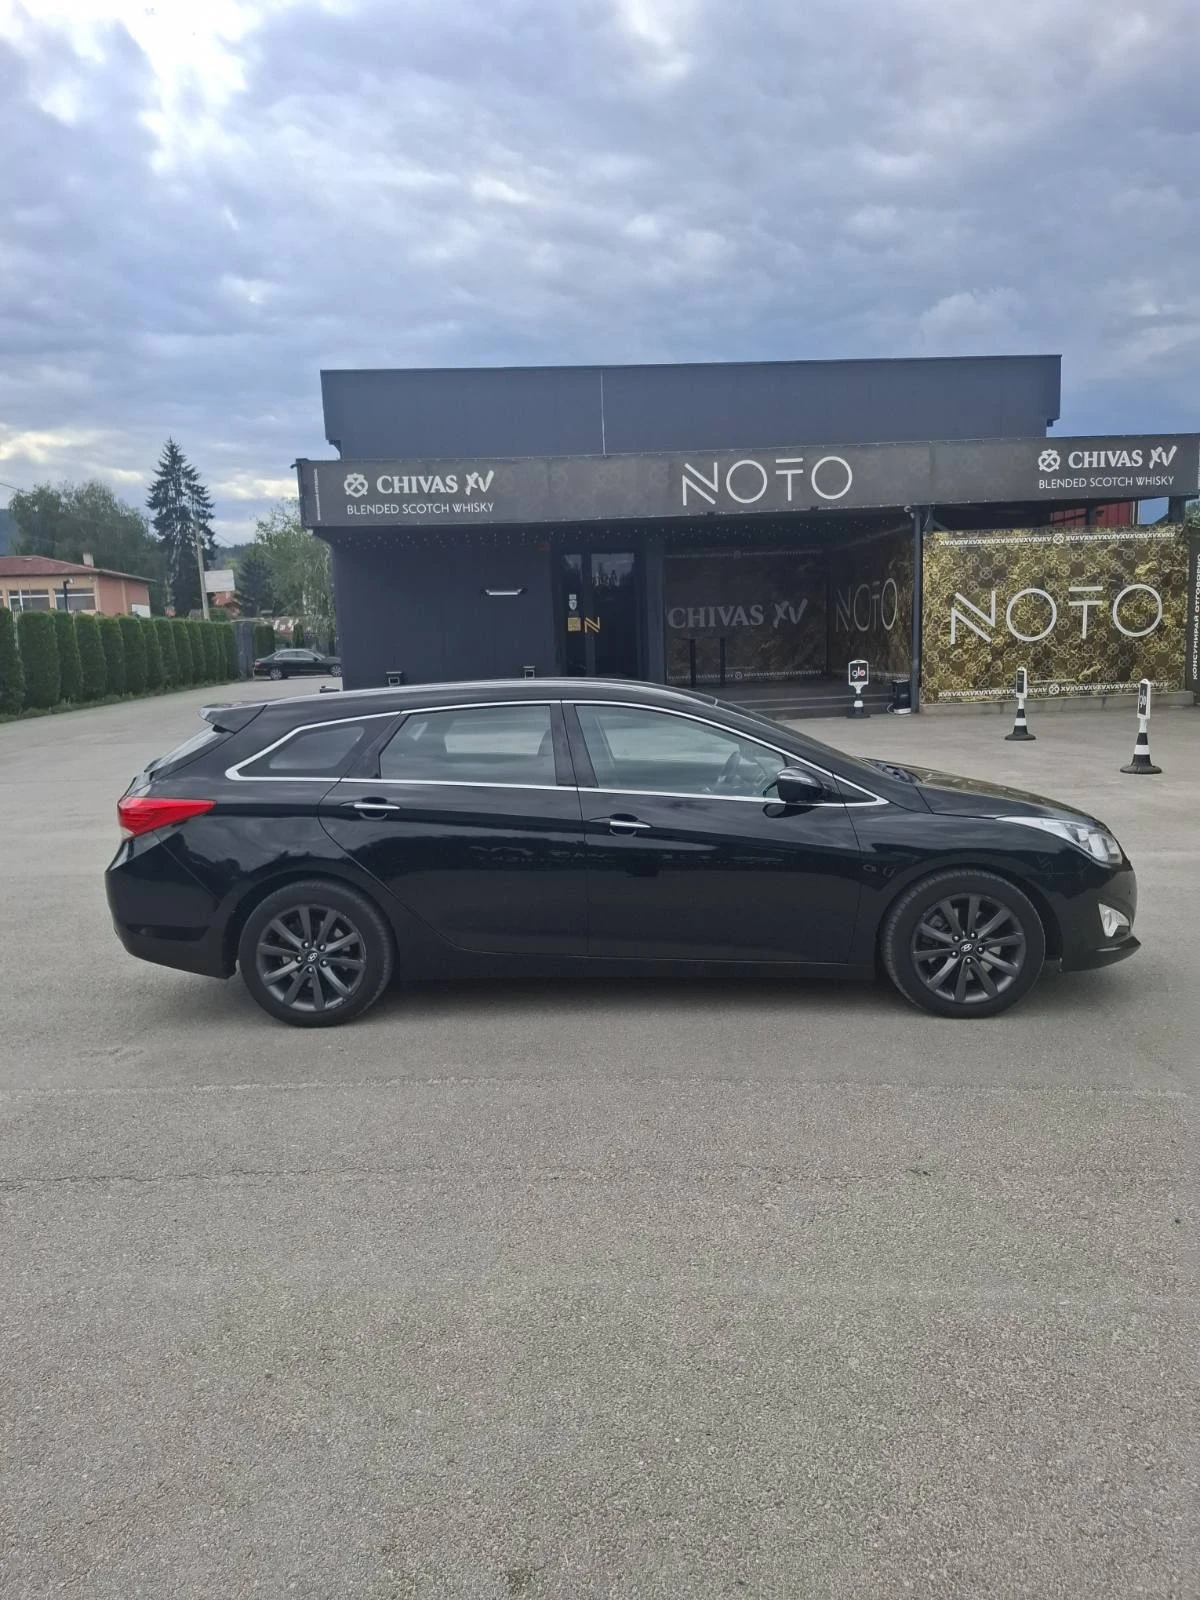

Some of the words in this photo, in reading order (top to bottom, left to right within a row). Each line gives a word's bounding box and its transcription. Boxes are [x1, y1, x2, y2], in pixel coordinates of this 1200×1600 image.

[1068, 449, 1143, 469] CHIVAS
[1149, 445, 1177, 469] XV
[376, 474, 458, 494] CHIVAS
[465, 470, 495, 496] XV
[682, 455, 853, 506] NOTO
[1038, 477, 1087, 489] BLENDED
[1089, 476, 1133, 487] SCOTCH
[1135, 475, 1175, 486] WHISKY
[347, 504, 399, 515] BLENDED
[402, 503, 450, 514] SCOTCH
[452, 502, 494, 513] WHISKY
[667, 605, 764, 629] CHIVAS
[773, 598, 808, 629] XV
[835, 578, 898, 632] NOTO
[950, 583, 1163, 645] NOTO
[851, 666, 866, 679] glo
